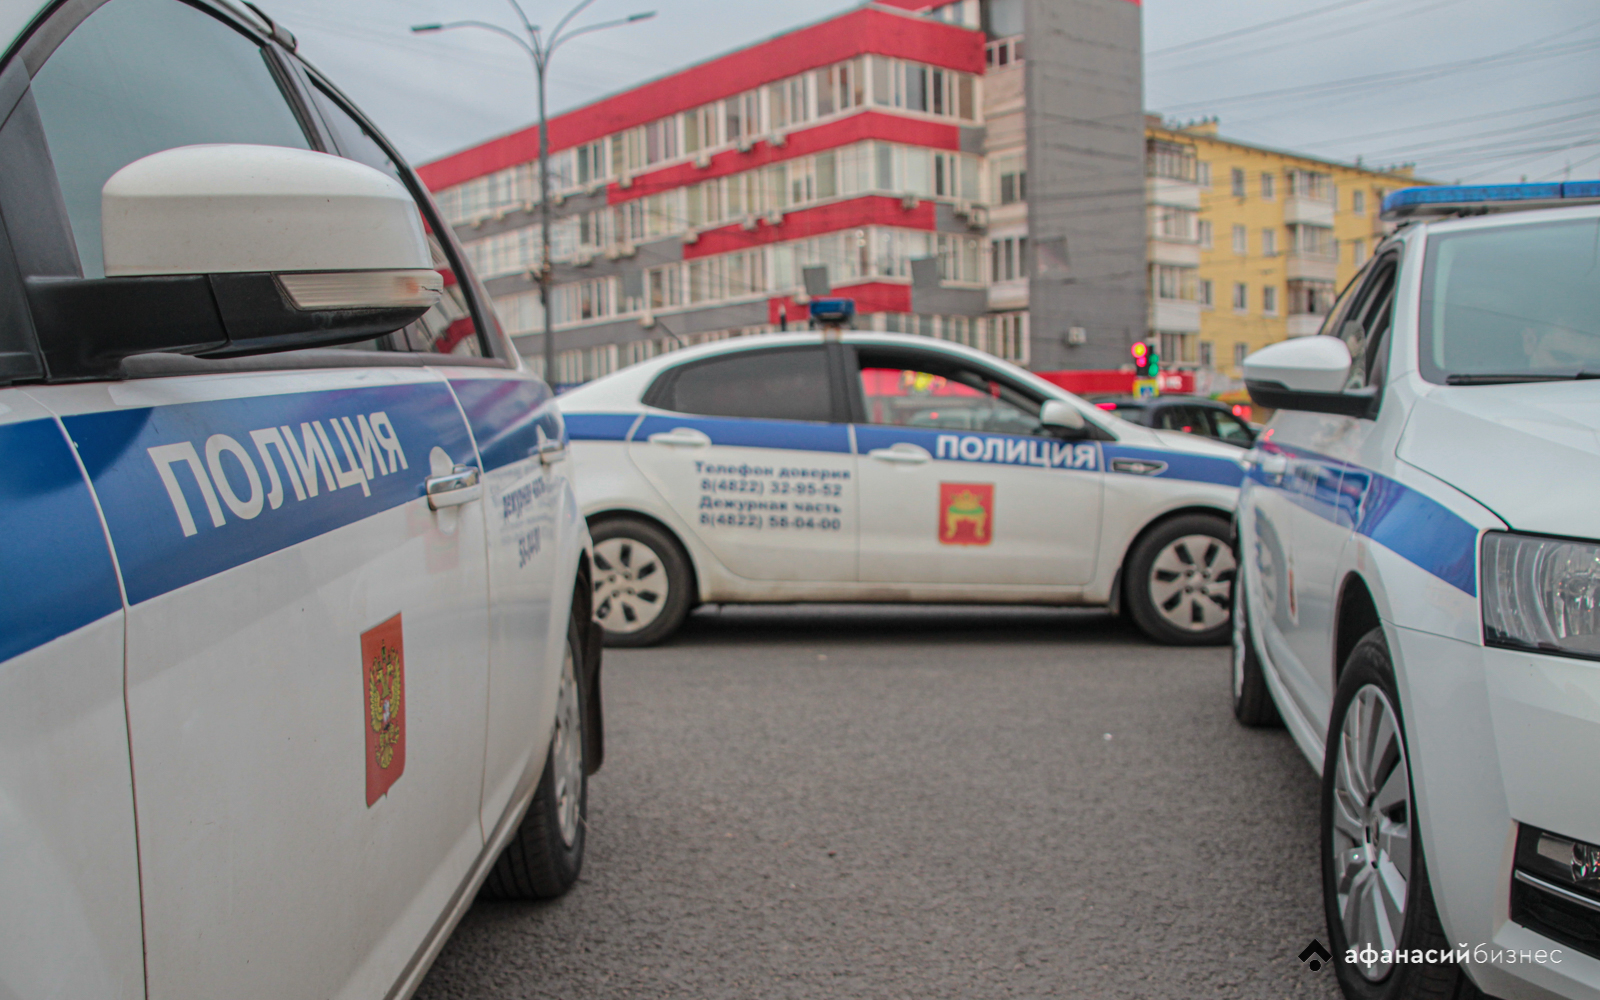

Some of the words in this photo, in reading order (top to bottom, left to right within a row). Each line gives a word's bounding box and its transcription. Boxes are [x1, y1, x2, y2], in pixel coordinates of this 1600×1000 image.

[936, 435, 1096, 469] ПОЛИЦИЯ
[147, 411, 408, 537] ПОЛИЦИЯ
[694, 461, 774, 477] Телефон
[779, 467, 851, 480] доверия
[701, 478, 764, 496] 8(4822)
[770, 481, 842, 497] 32-95-52
[699, 496, 788, 511] Дежурная
[794, 502, 841, 514] часть
[700, 513, 763, 531] 8(4822)
